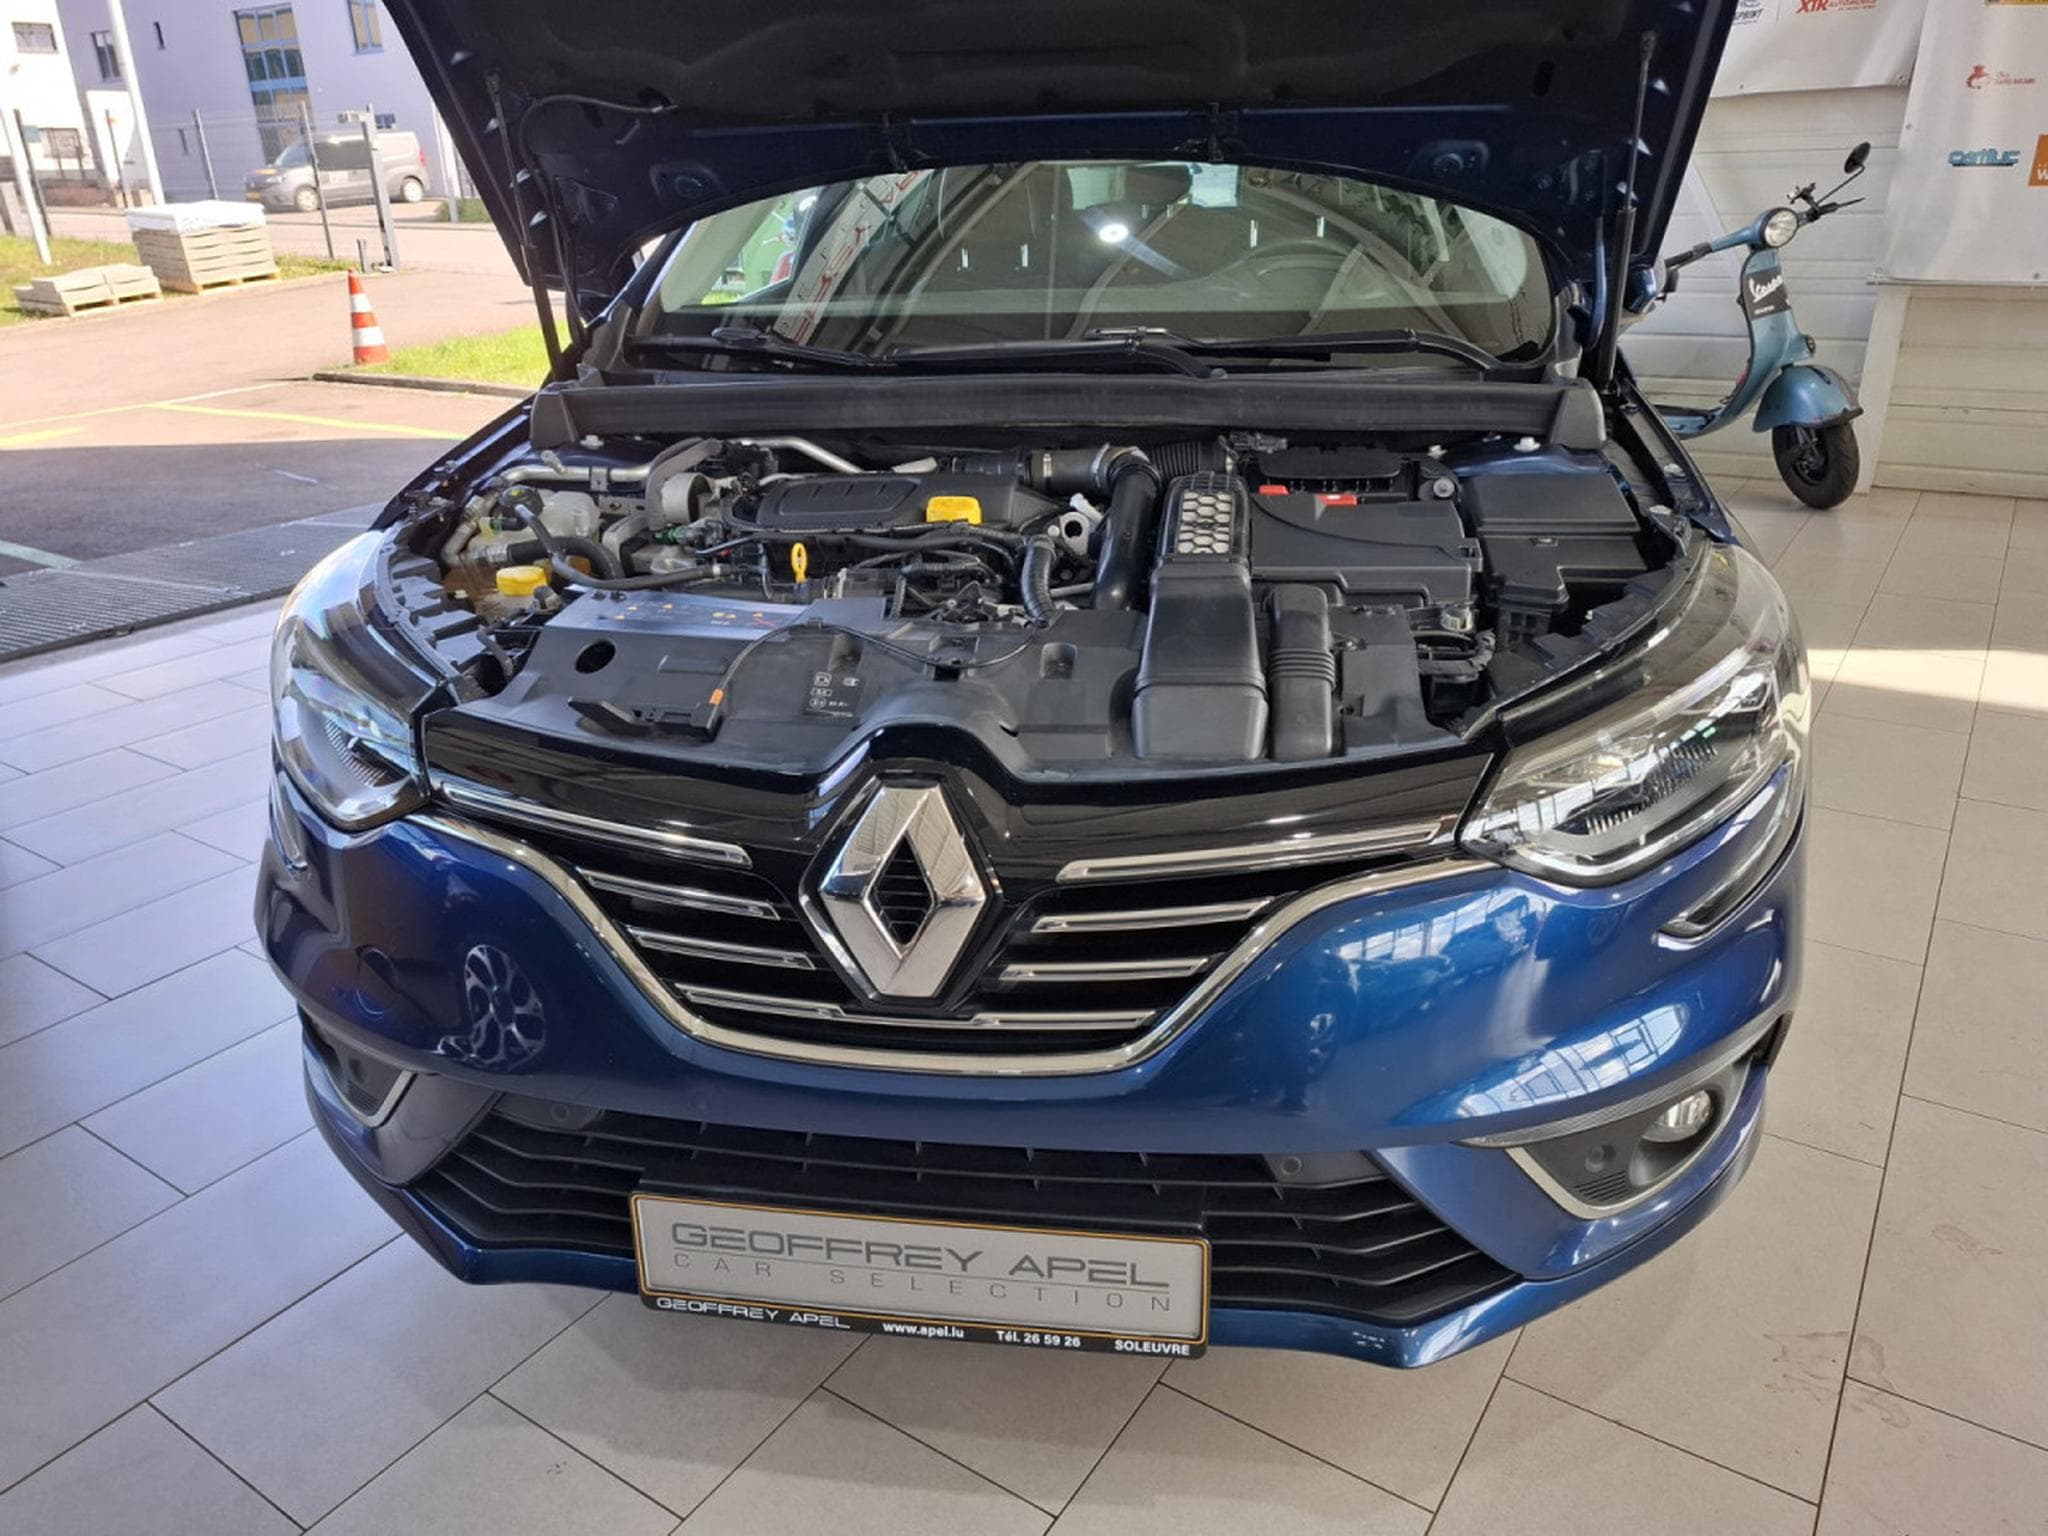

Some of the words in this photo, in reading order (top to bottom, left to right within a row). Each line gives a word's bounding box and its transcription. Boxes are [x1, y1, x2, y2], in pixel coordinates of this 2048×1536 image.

[672, 1222, 983, 1273] GEOFFREY
[1008, 1254, 1170, 1288] APEL
[673, 1253, 772, 1278] CAR
[830, 1269, 1170, 1312] SELECTION
[656, 1297, 779, 1321] GEOFFREY
[789, 1312, 850, 1329] APEL
[883, 1323, 965, 1339] www.apel.lu
[996, 1330, 1021, 1344] Tél.
[1024, 1333, 1041, 1345] 26
[1043, 1334, 1061, 1346] 59
[1064, 1336, 1081, 1348] 26
[1114, 1339, 1190, 1356] SOLEUVRE
